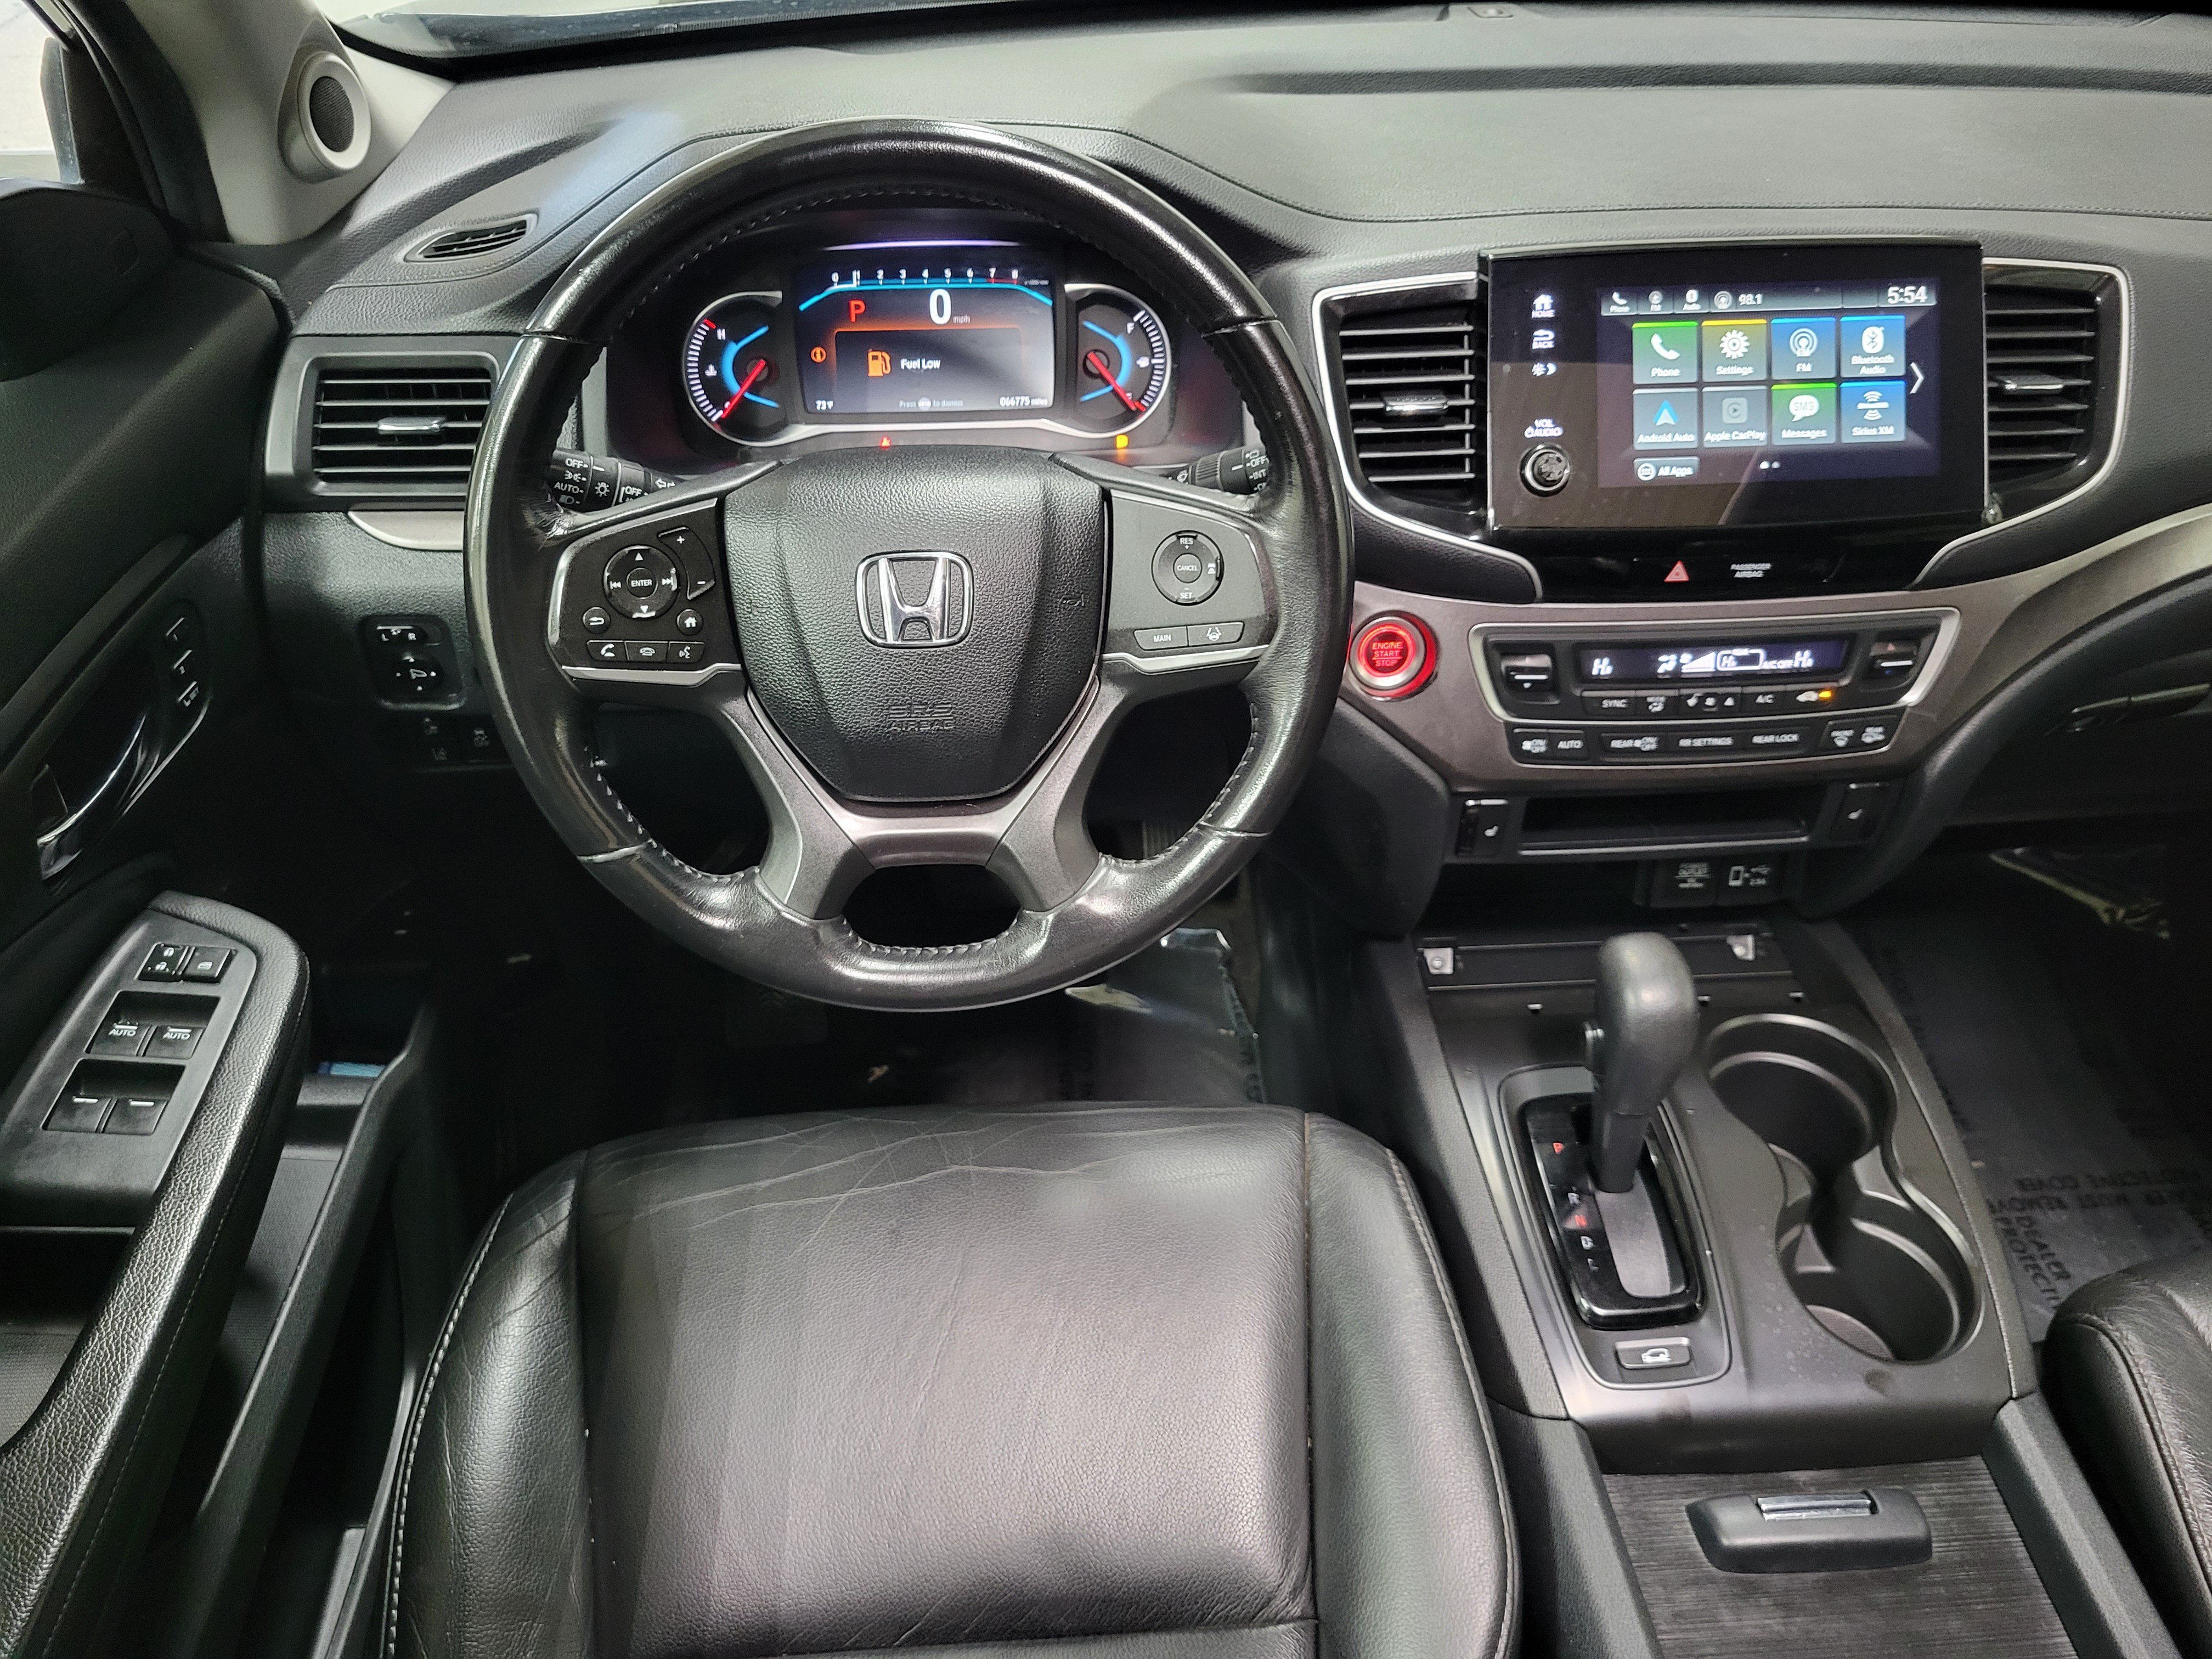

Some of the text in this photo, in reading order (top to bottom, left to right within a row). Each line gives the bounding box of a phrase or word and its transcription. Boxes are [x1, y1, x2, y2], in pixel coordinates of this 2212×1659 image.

[832, 272, 839, 282] 0
[877, 269, 884, 279] 2
[899, 268, 907, 279] 3
[922, 268, 929, 278] 4
[944, 268, 952, 278] 5
[967, 268, 974, 278] 6
[989, 267, 996, 278] 7
[1011, 269, 1019, 280] 8
[1738, 294, 1763, 305] 98.1
[1887, 285, 1928, 304] 5:54
[848, 300, 866, 323] P
[929, 289, 970, 325] 0 mph
[1531, 309, 1556, 319] HOME
[1126, 322, 1135, 334] F
[716, 329, 726, 340] H
[1532, 341, 1555, 349] BACK
[900, 358, 941, 370] Fuel Low
[1851, 354, 1894, 365] Bluetooth
[1651, 366, 1681, 377] Phone
[1716, 365, 1754, 376] Settings
[1796, 363, 1812, 373] FM
[1859, 365, 1886, 375] Audio
[1000, 396, 1030, 407] 066775
[1793, 402, 1814, 411] SMS
[1534, 419, 1555, 427] VOL
[1533, 427, 1564, 437] AUDIO
[1704, 429, 1767, 442] Apple CarPlay
[1781, 429, 1827, 439] Messages
[1878, 426, 1895, 436] XM
[1637, 432, 1696, 443] Android Auto
[565, 458, 584, 469] OFF
[1250, 455, 1267, 467] OFF
[1252, 469, 1267, 480] INT
[1657, 465, 1695, 477] All Apps
[554, 482, 580, 493] AUTO
[625, 486, 642, 496] OFF
[381, 633, 389, 641] L
[408, 632, 417, 641] R
[1372, 641, 1403, 650] ENGINE
[1601, 698, 1629, 708] SYNC
[1756, 694, 1776, 704] A/C
[1774, 733, 1799, 742] LOCK
[1558, 740, 1584, 749] AUTO
[1610, 740, 1634, 748] REAR
[109, 1029, 137, 1037] AUTO
[163, 1031, 190, 1040] AUTO
[1553, 1142, 1565, 1154] P
[1567, 1192, 1581, 1205] R
[1575, 1215, 1588, 1227] N
[1580, 1235, 1594, 1250] D
[1587, 1258, 1599, 1272] L
